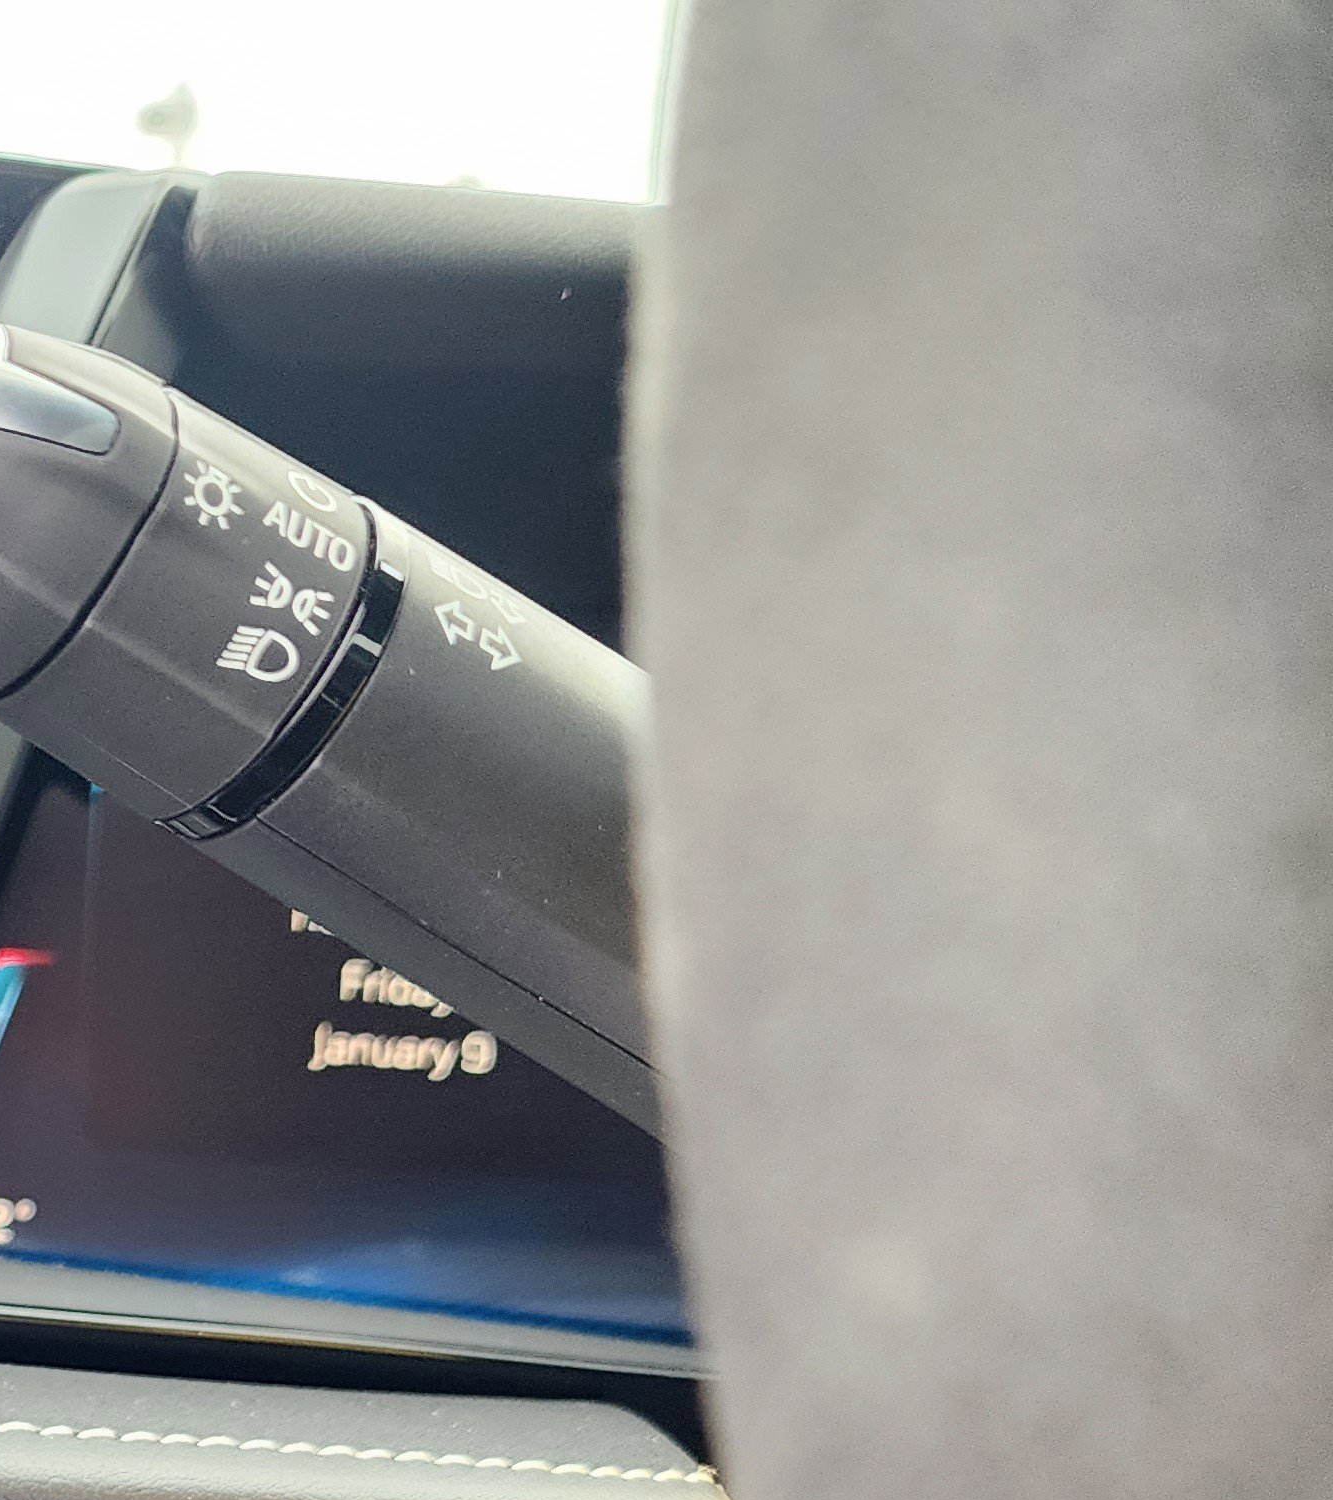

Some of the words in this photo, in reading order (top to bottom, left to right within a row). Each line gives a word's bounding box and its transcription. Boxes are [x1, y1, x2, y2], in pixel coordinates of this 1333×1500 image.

[263, 499, 355, 572] AUTO
[307, 1020, 461, 1082] January
[460, 1030, 498, 1075] 9
